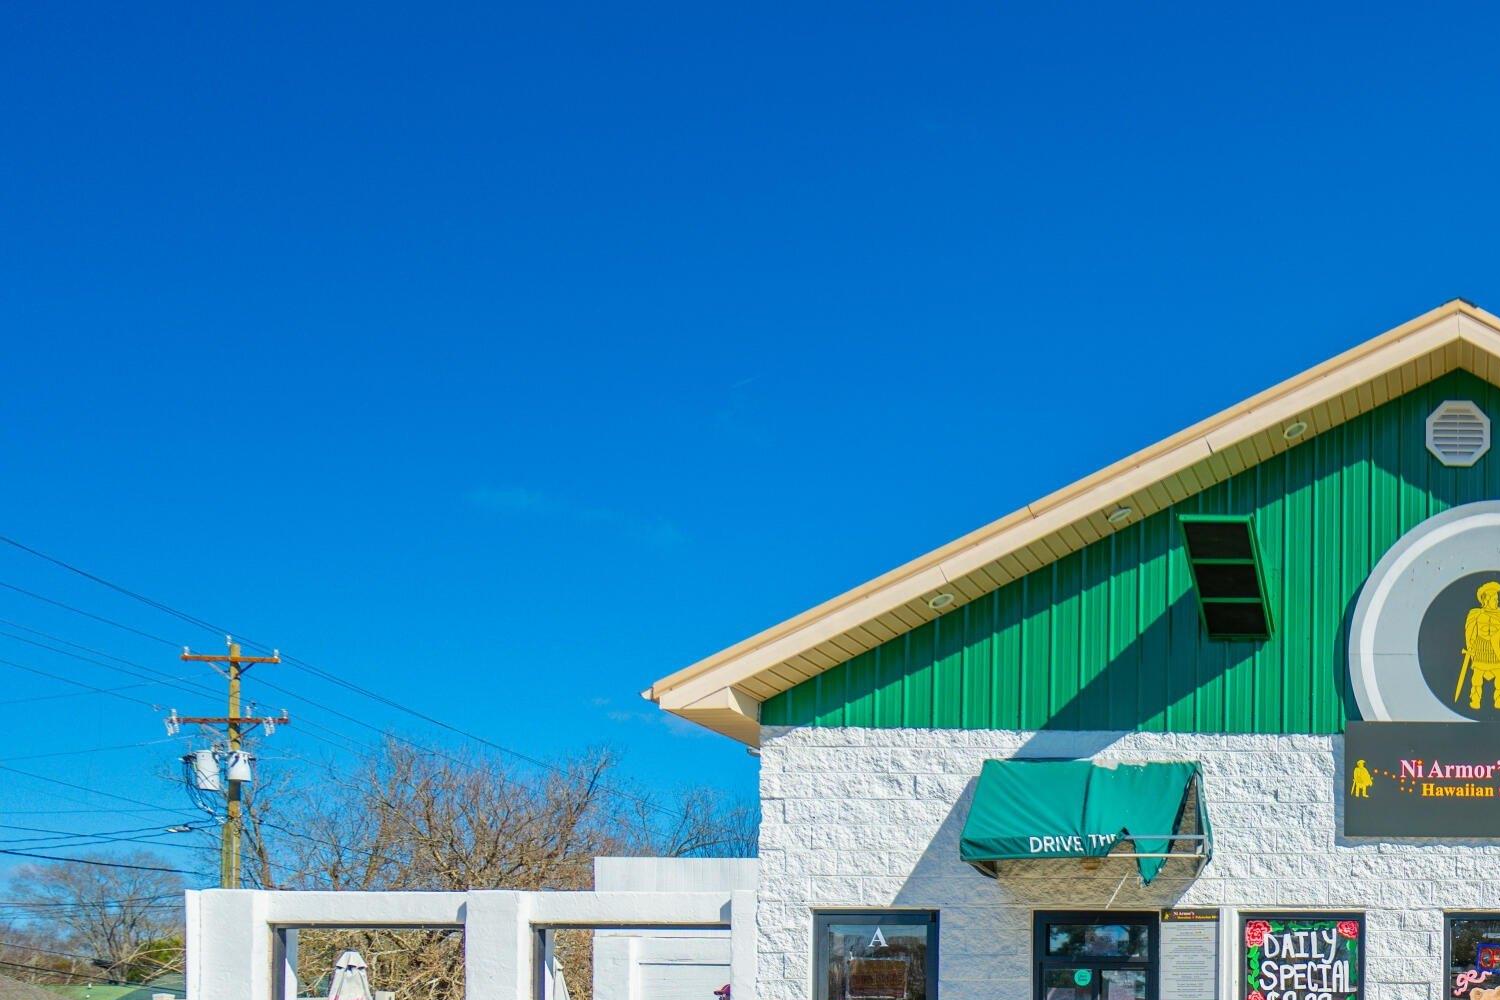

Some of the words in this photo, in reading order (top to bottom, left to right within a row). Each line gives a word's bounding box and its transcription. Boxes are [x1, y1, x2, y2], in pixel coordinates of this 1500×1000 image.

[1399, 759, 1424, 779] Ni
[1421, 783, 1495, 798] Hawaiian
[1029, 835, 1084, 854] DRIVE
[867, 927, 889, 947] A
[1263, 927, 1337, 964] DAILY
[1259, 960, 1357, 993] SPECIAL
